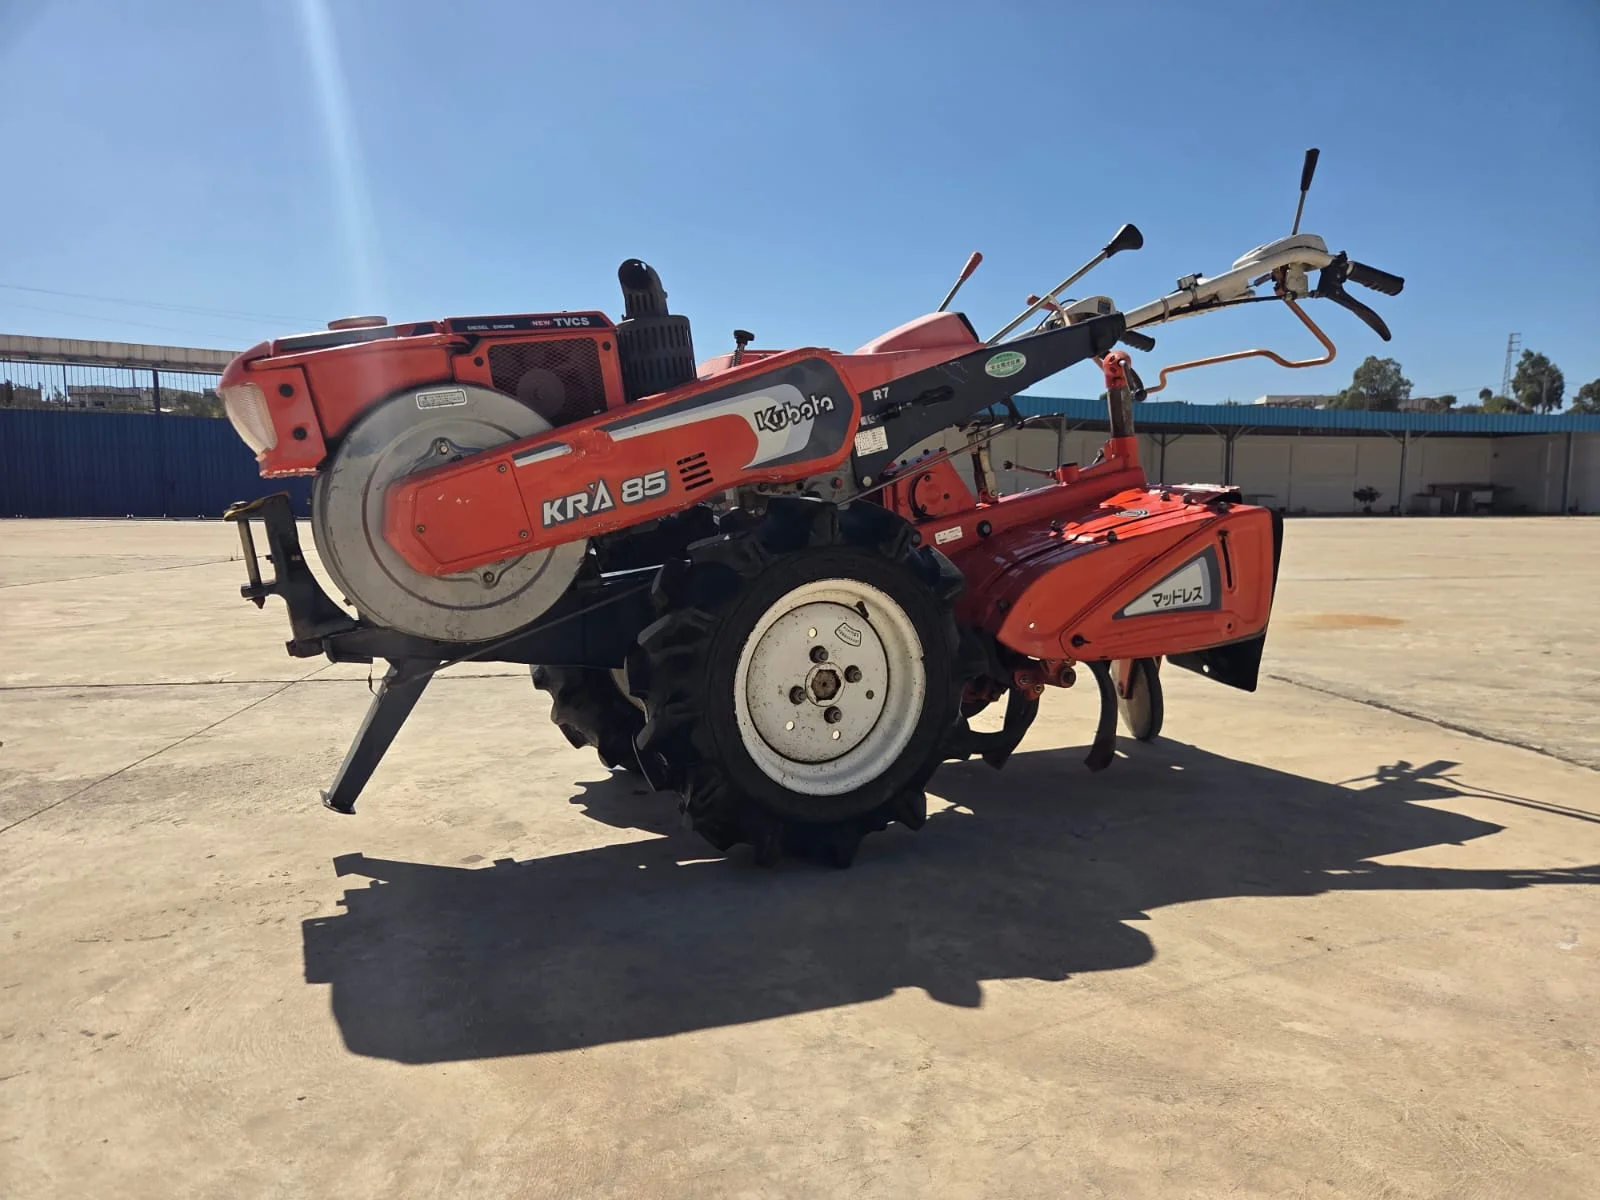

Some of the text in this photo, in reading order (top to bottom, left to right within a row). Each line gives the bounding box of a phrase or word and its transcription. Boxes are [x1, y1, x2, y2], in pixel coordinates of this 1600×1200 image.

[553, 317, 590, 328] TVCS
[872, 387, 889, 401] R7
[754, 394, 834, 431] Kubota
[543, 470, 667, 526] KRA 85
[1152, 586, 1203, 608] マッドレス
